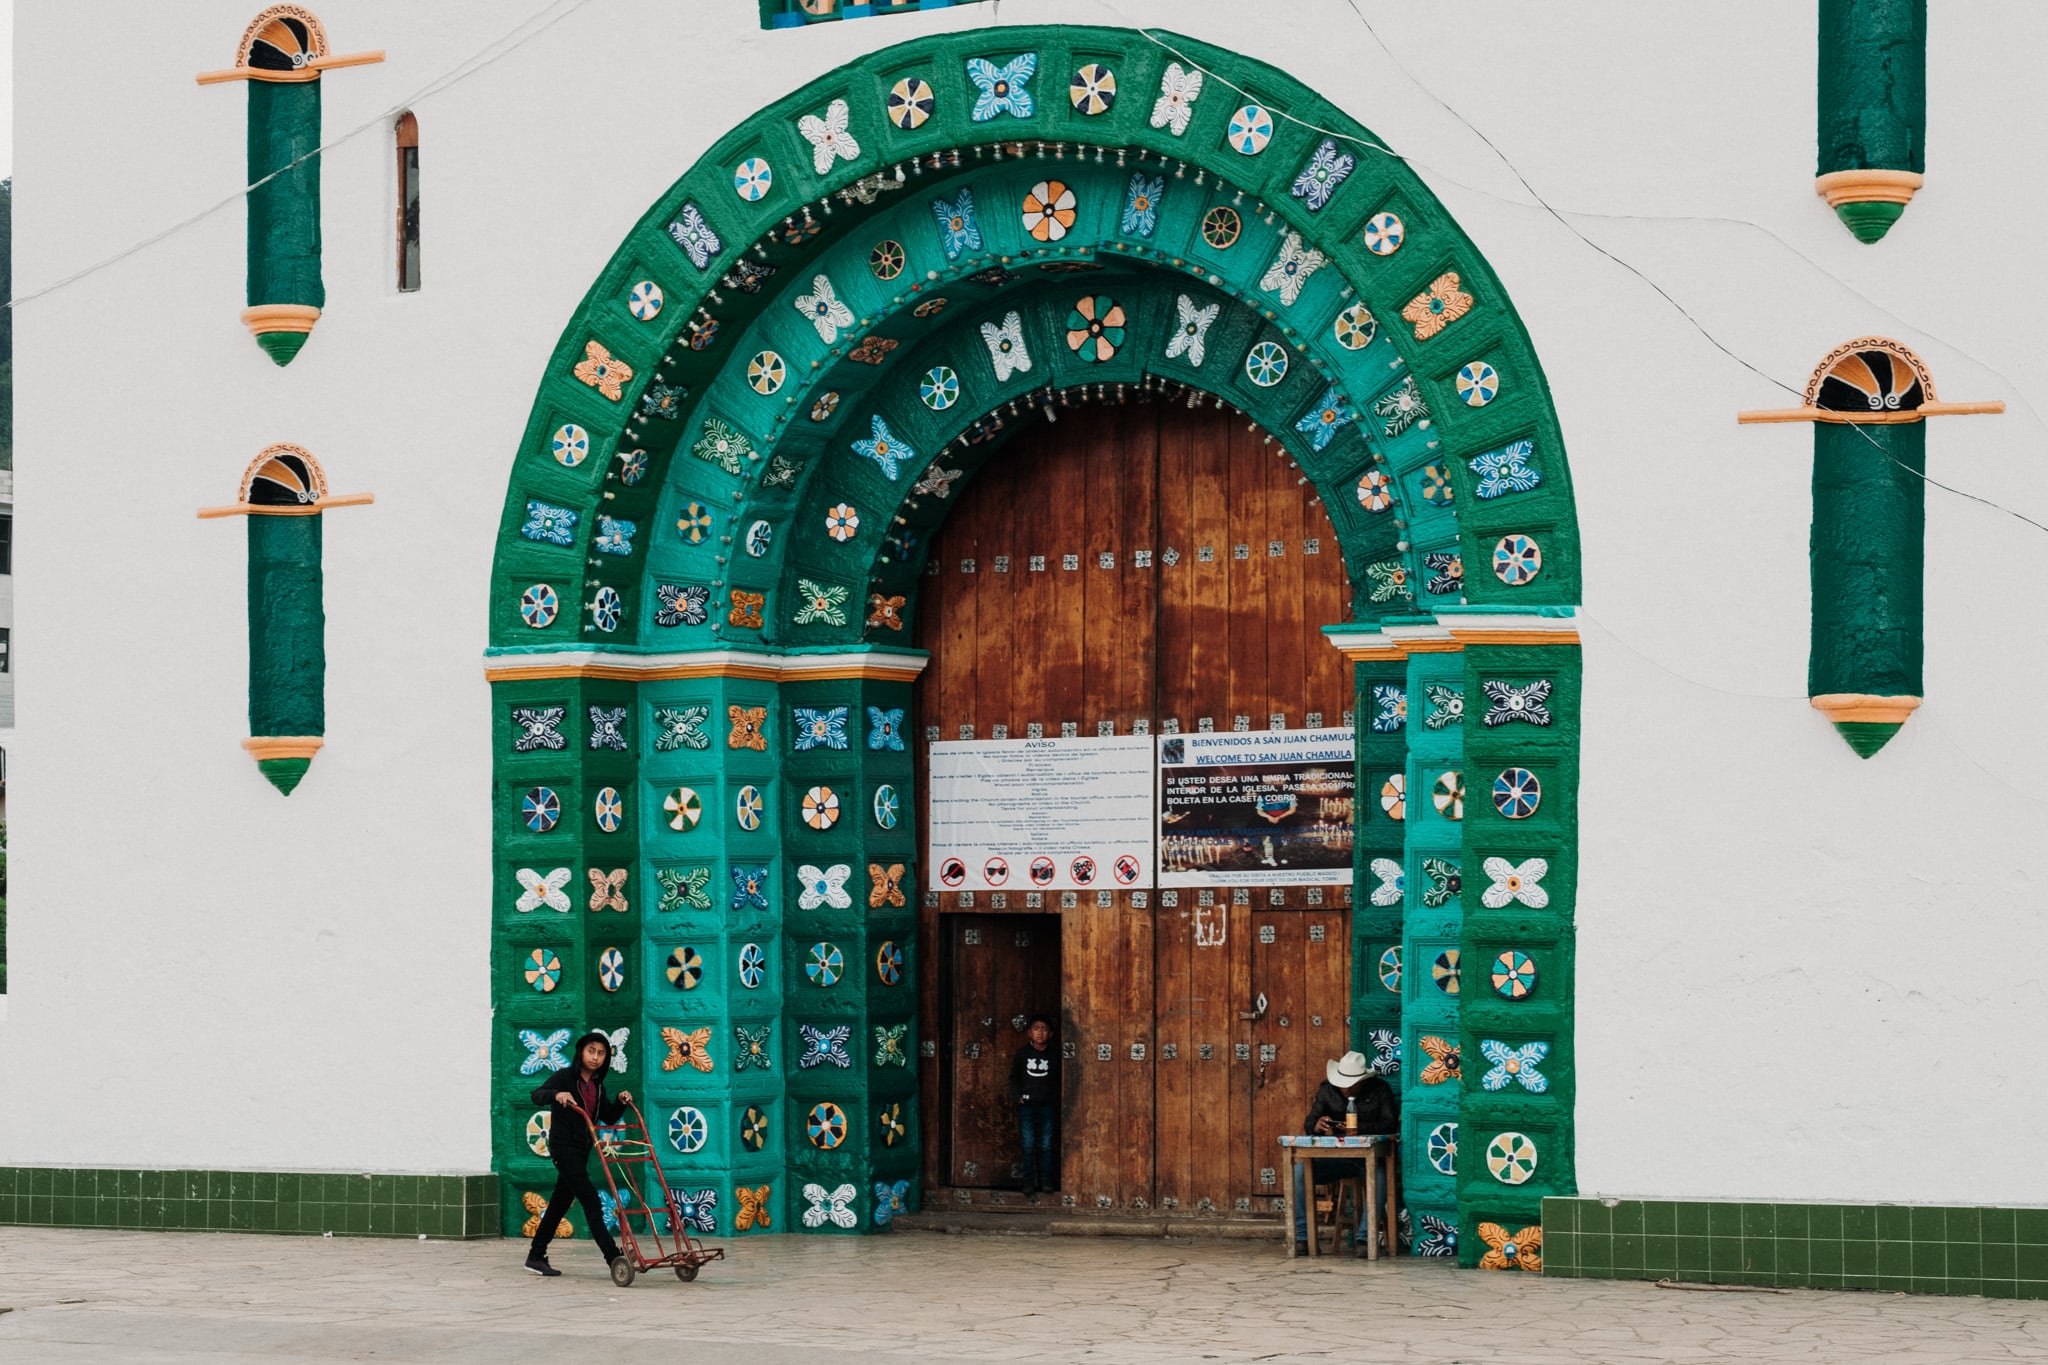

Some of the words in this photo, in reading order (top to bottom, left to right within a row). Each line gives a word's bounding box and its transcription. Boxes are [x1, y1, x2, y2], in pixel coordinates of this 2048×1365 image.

[1192, 737, 1252, 747] BIENVENIDOS
[1254, 736, 1261, 745] A
[1263, 736, 1281, 744] SAN
[1283, 735, 1307, 744] JUAN
[1309, 732, 1354, 742] CHAMULA
[1196, 755, 1241, 764] WELCOME
[1244, 754, 1256, 762] TO
[1259, 753, 1276, 761] SAN
[1280, 752, 1302, 760] JUAN
[1306, 750, 1352, 759] CHAMULA
[1178, 777, 1206, 785] USTED
[1209, 776, 1238, 784] DESEA
[1241, 775, 1259, 783] UNA
[1167, 786, 1206, 795] INTERIOR
[1167, 797, 1200, 805] BOLETA
[1229, 795, 1263, 803] CASETA
